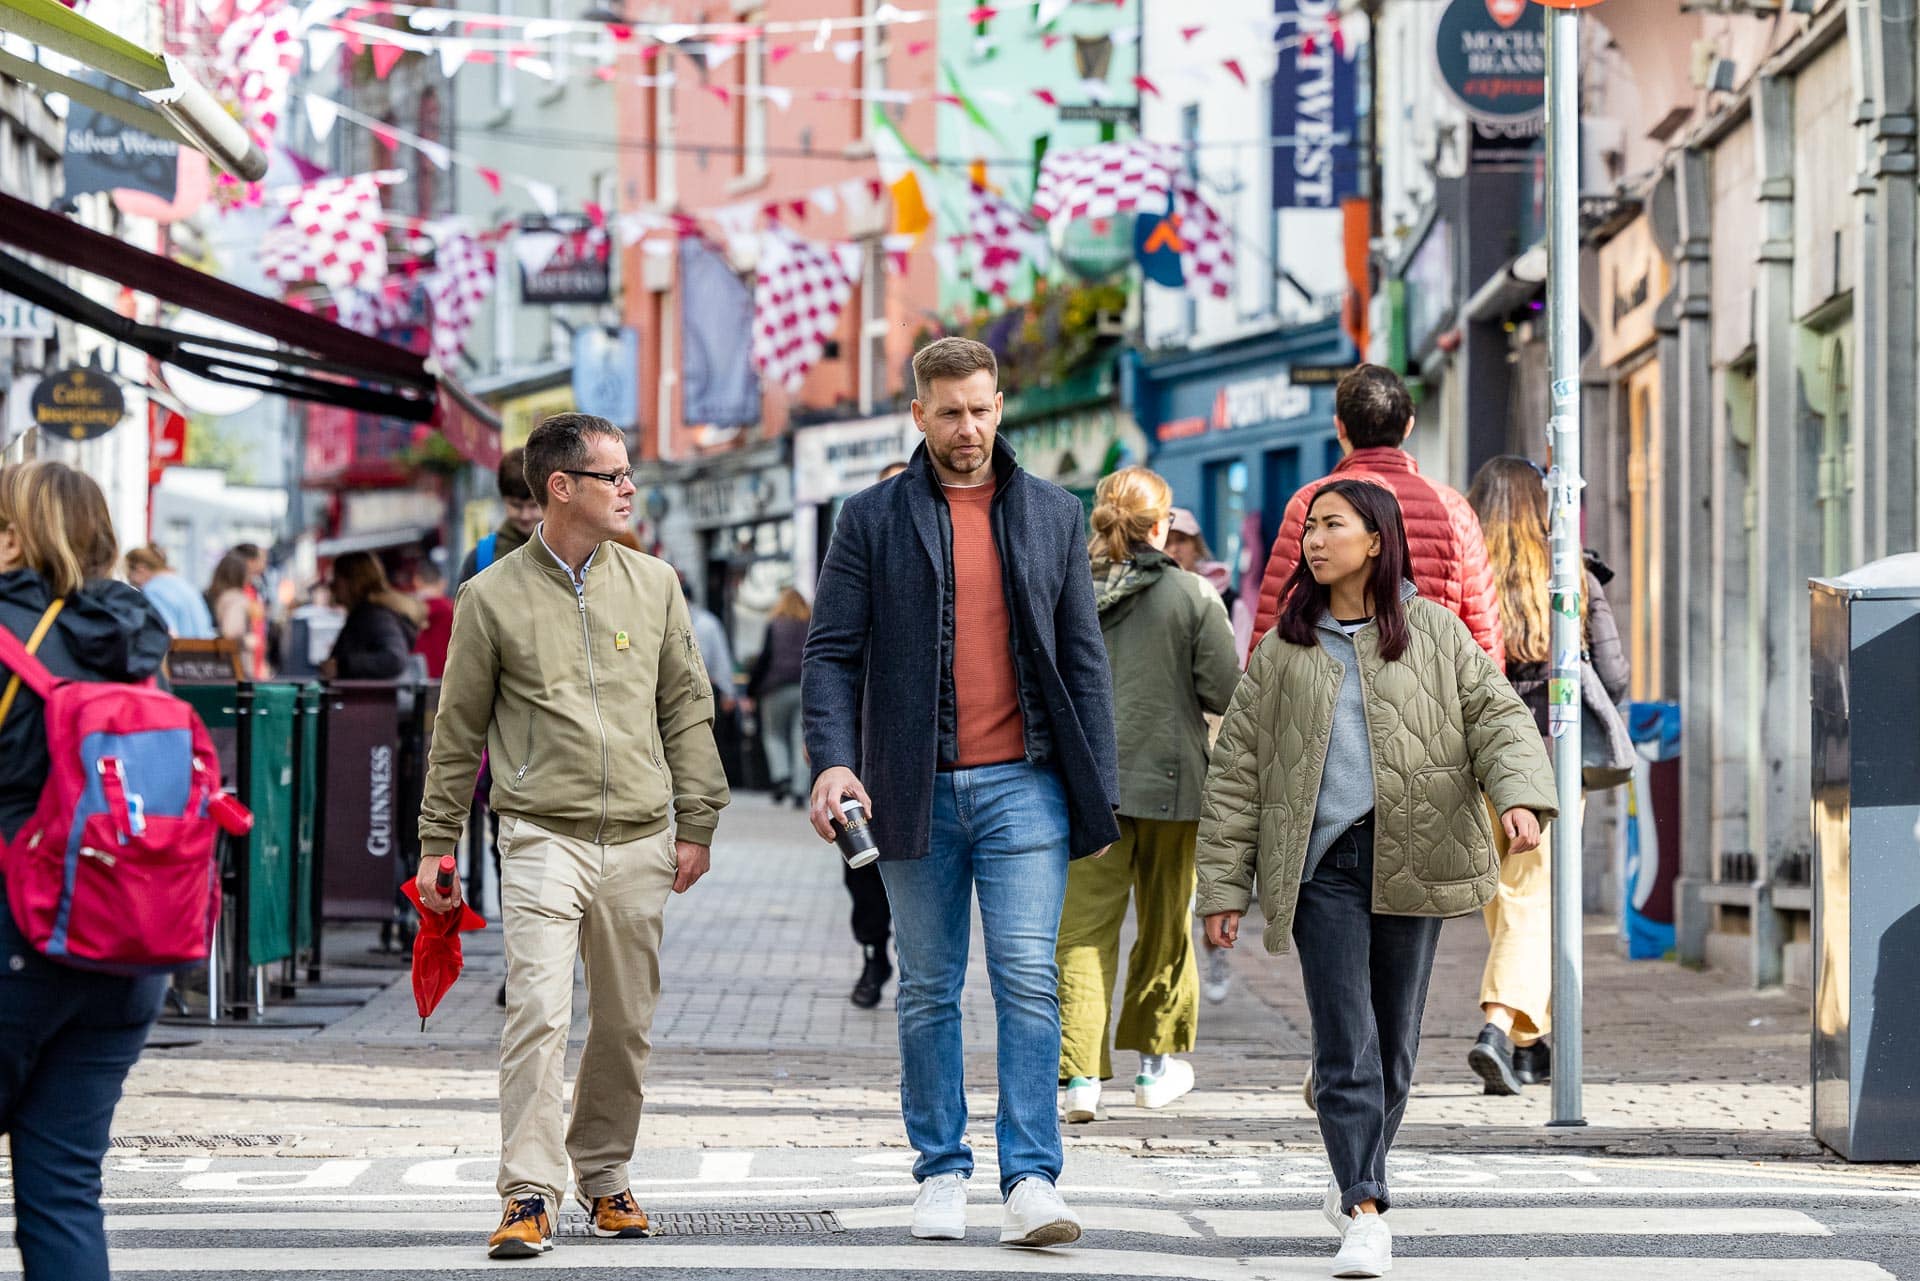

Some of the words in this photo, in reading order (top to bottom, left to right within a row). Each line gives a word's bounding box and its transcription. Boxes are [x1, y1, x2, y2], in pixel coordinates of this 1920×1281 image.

[1468, 53, 1544, 74] BEANS
[68, 129, 120, 154] Silver
[52, 383, 103, 405] Celtic
[366, 745, 392, 857] GUINNESS
